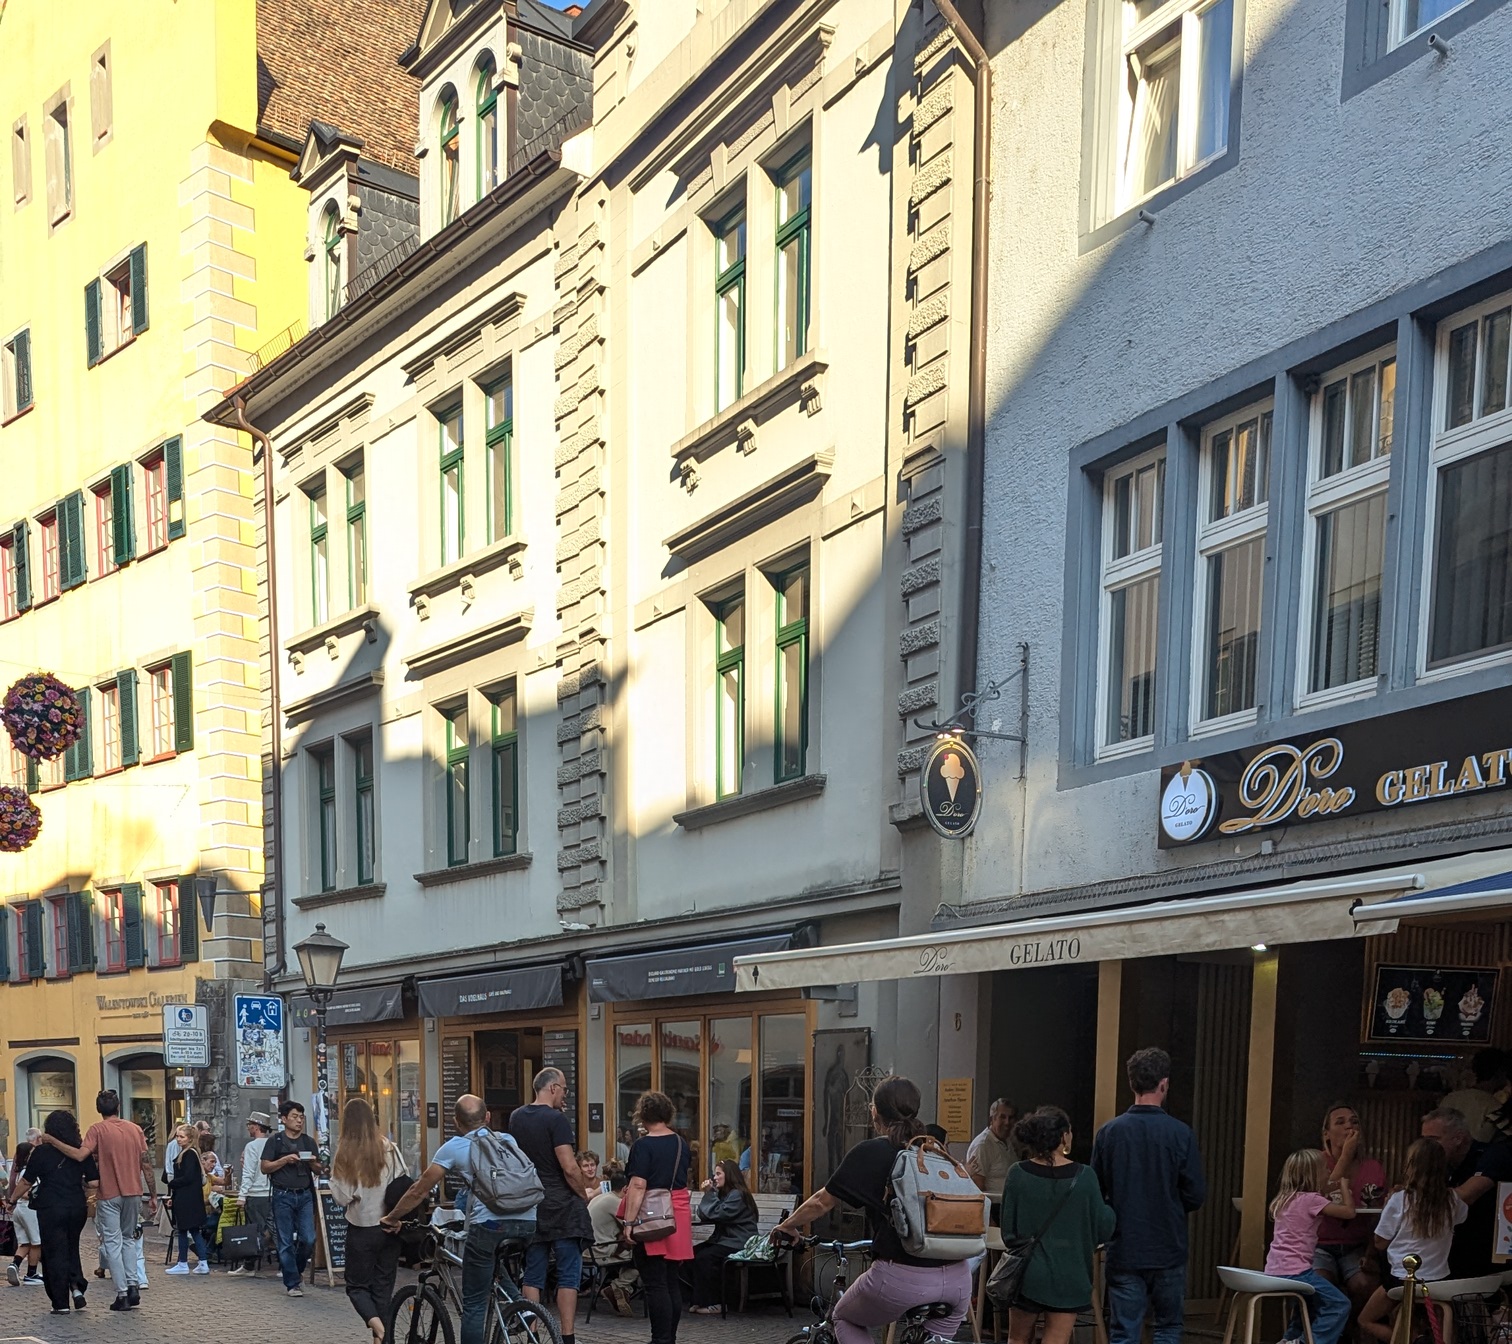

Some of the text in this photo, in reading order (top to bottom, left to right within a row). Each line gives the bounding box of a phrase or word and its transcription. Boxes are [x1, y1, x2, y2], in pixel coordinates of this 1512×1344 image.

[1375, 747, 1512, 806] GELAT
[1174, 820, 1193, 828] GELATO
[1009, 937, 1081, 965] GELATO
[459, 994, 467, 1003] DAS
[333, 1245, 346, 1253] Kauf
